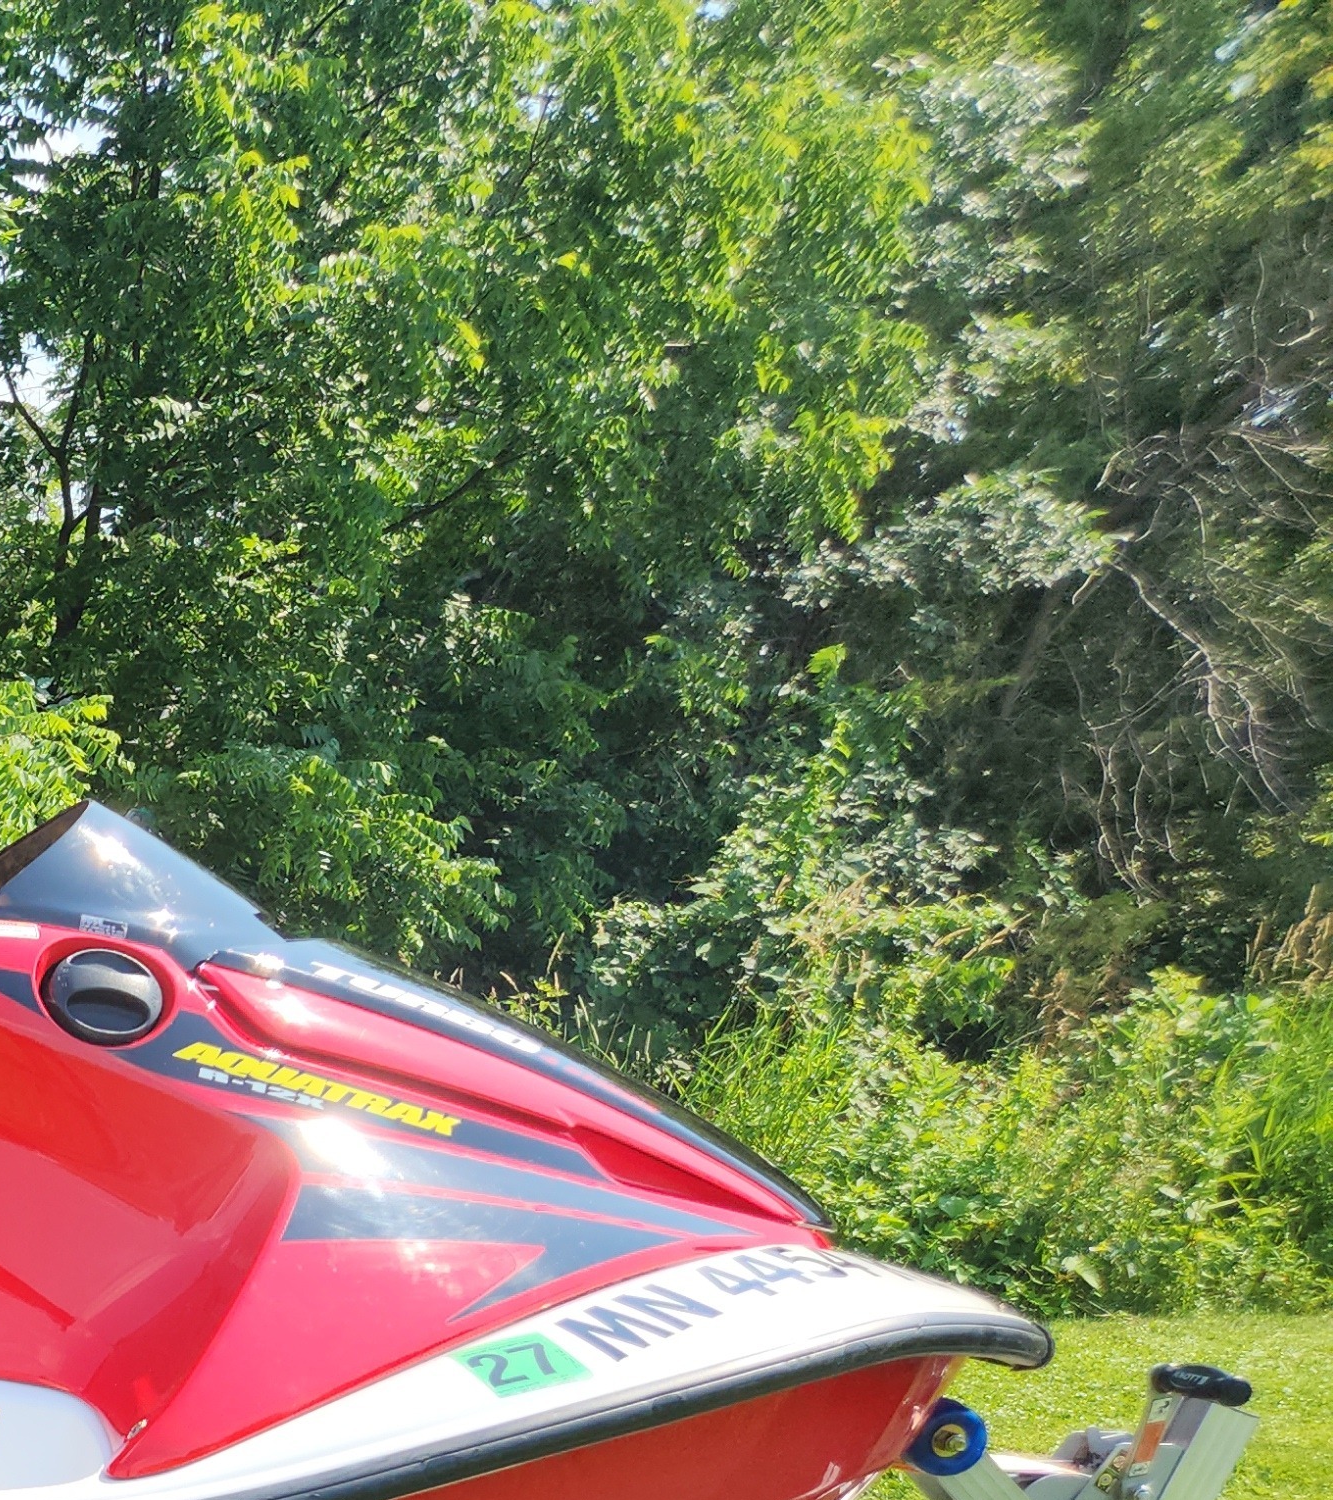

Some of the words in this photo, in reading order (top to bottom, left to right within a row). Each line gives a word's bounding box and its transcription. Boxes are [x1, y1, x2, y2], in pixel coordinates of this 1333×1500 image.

[311, 961, 543, 1053] TURBO
[172, 1041, 461, 1136] AQUATRAX
[197, 1067, 324, 1110] R-12X
[555, 1283, 723, 1362] MN
[466, 1342, 557, 1388] 27
